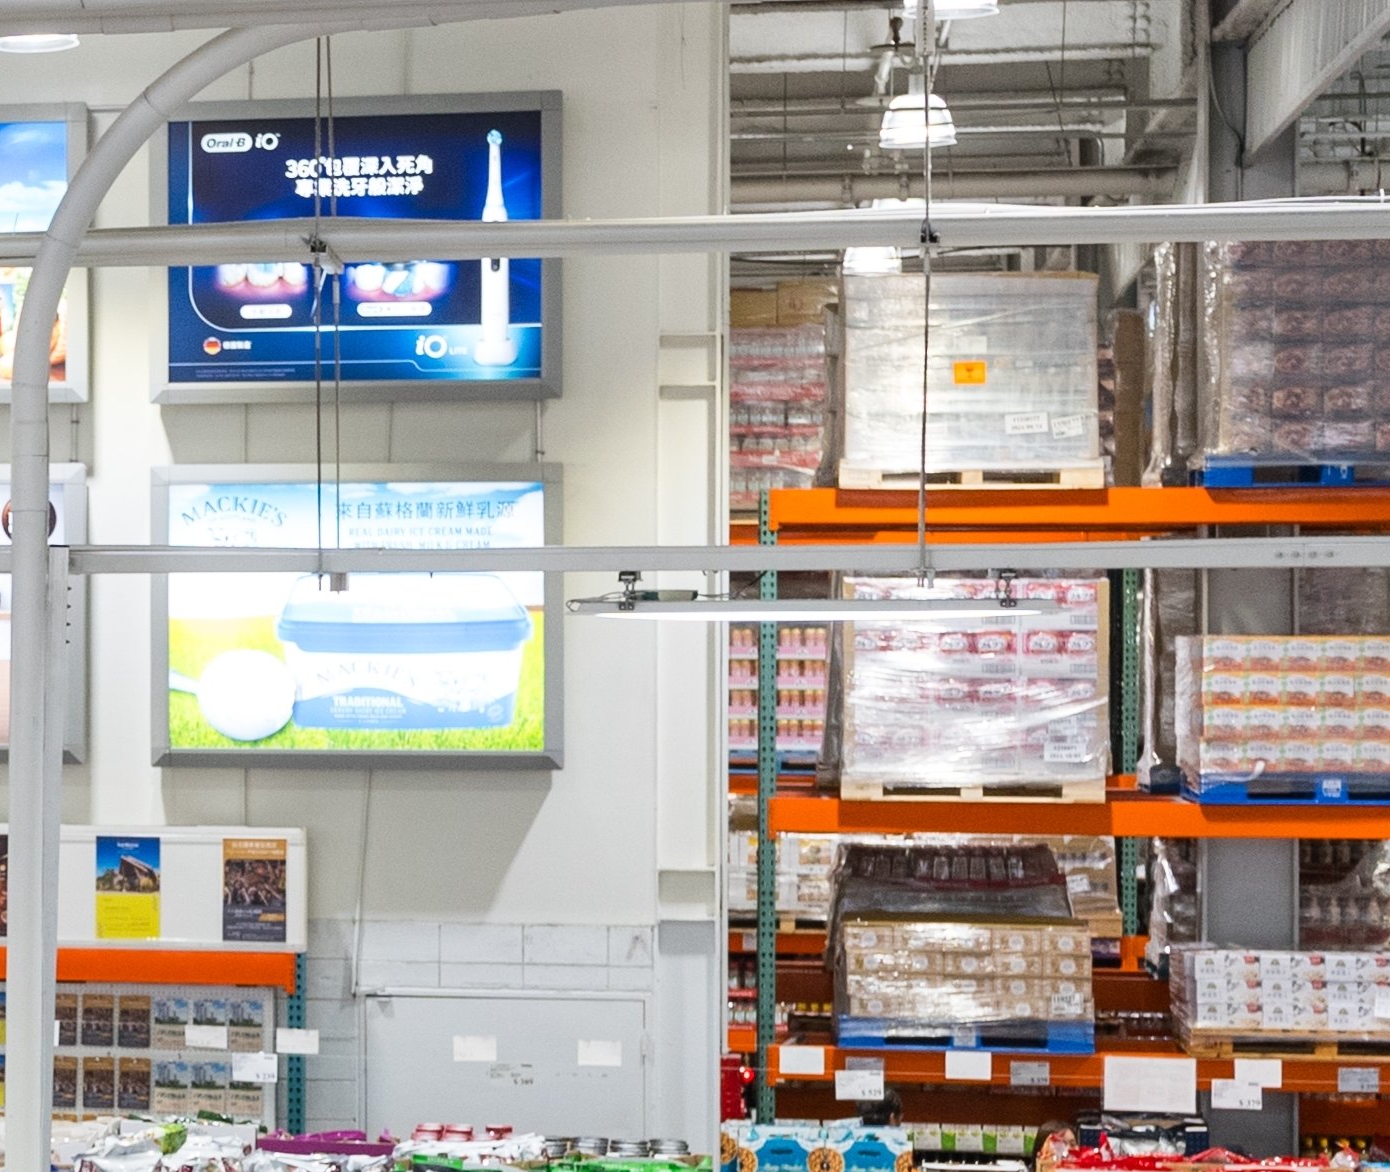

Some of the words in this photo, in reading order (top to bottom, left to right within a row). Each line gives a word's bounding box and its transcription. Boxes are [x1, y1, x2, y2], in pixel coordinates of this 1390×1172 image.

[181, 496, 288, 527] MACKIE'S
[428, 527, 462, 536] CREAM
[466, 526, 492, 536] MADE
